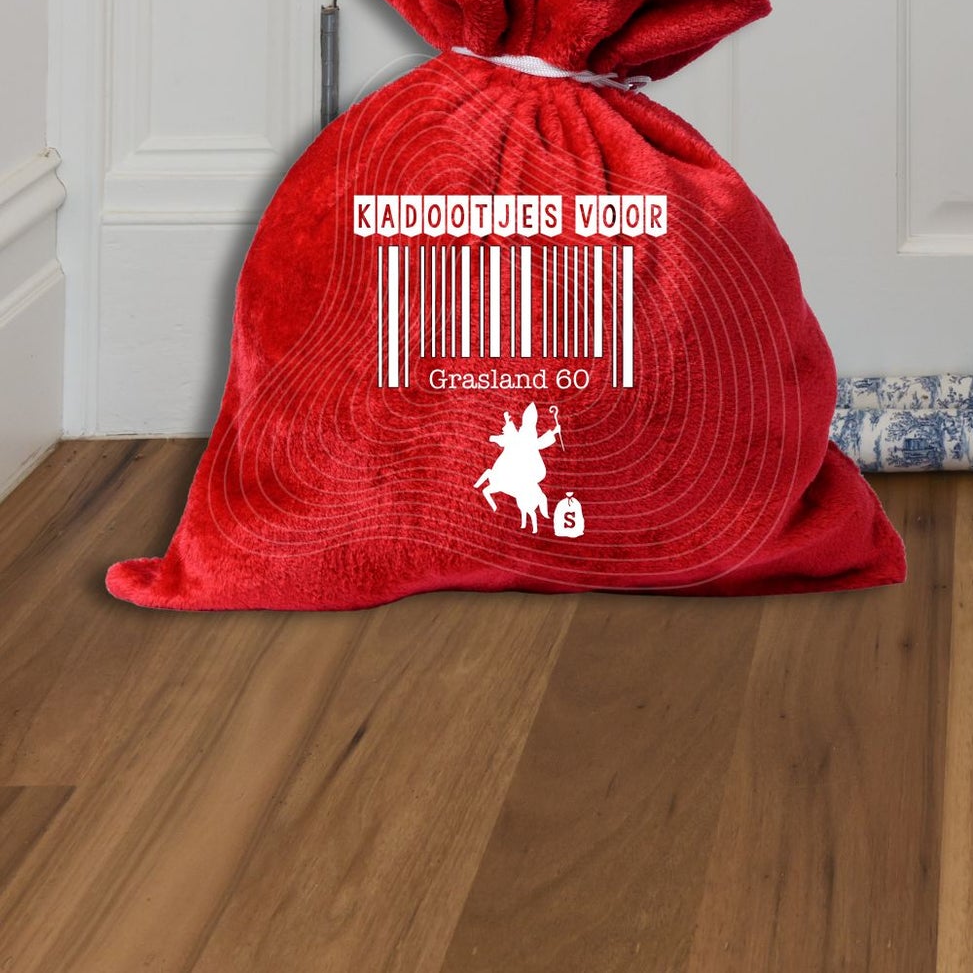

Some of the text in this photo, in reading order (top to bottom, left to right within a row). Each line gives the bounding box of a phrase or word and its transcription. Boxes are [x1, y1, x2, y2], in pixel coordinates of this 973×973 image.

[357, 201, 664, 230] KADOOTJES VOOR
[428, 368, 591, 391] Grasland 60
[563, 511, 576, 529] S
